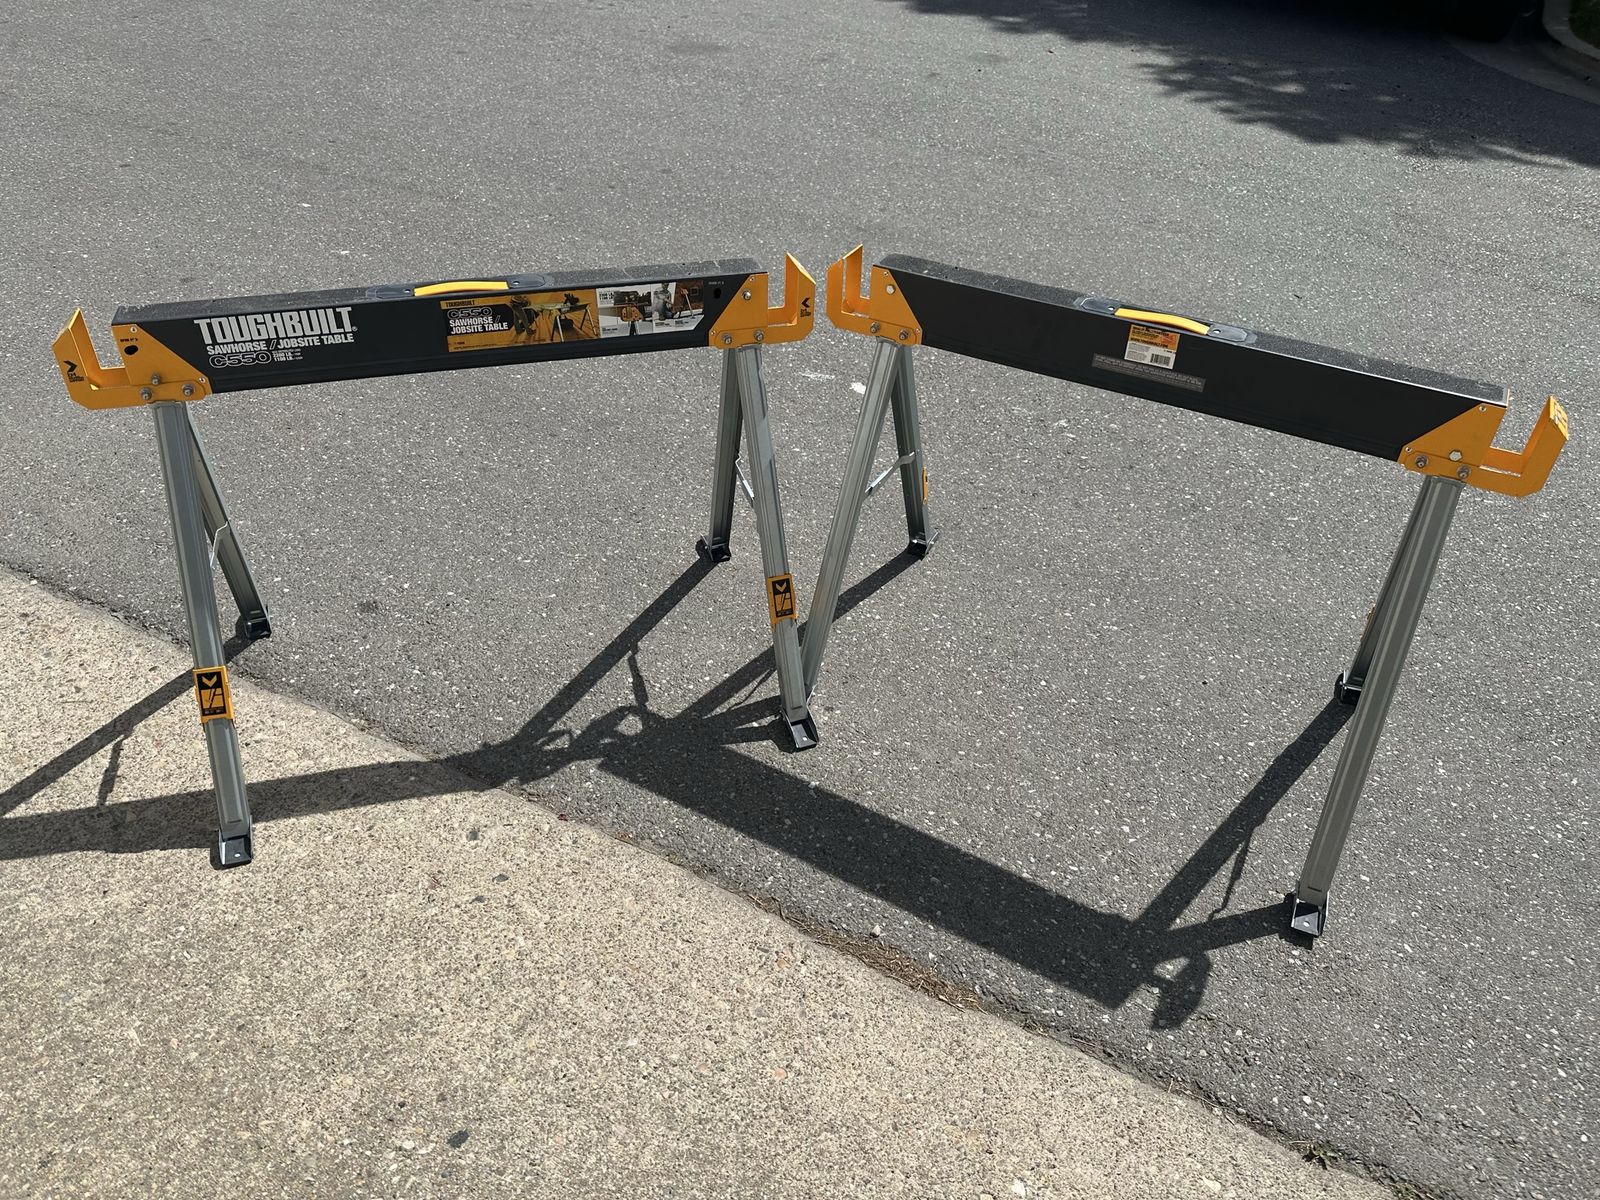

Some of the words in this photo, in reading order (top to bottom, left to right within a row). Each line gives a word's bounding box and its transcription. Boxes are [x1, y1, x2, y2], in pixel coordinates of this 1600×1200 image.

[447, 307, 492, 320] C550
[449, 316, 493, 327] SAWHORSE
[451, 324, 483, 335] JOBSITE
[484, 322, 509, 331] TABLE
[206, 340, 268, 355] SAWHORSE
[277, 335, 321, 349] JOBSITE
[321, 333, 355, 345] TABLE
[209, 350, 272, 368] C550
